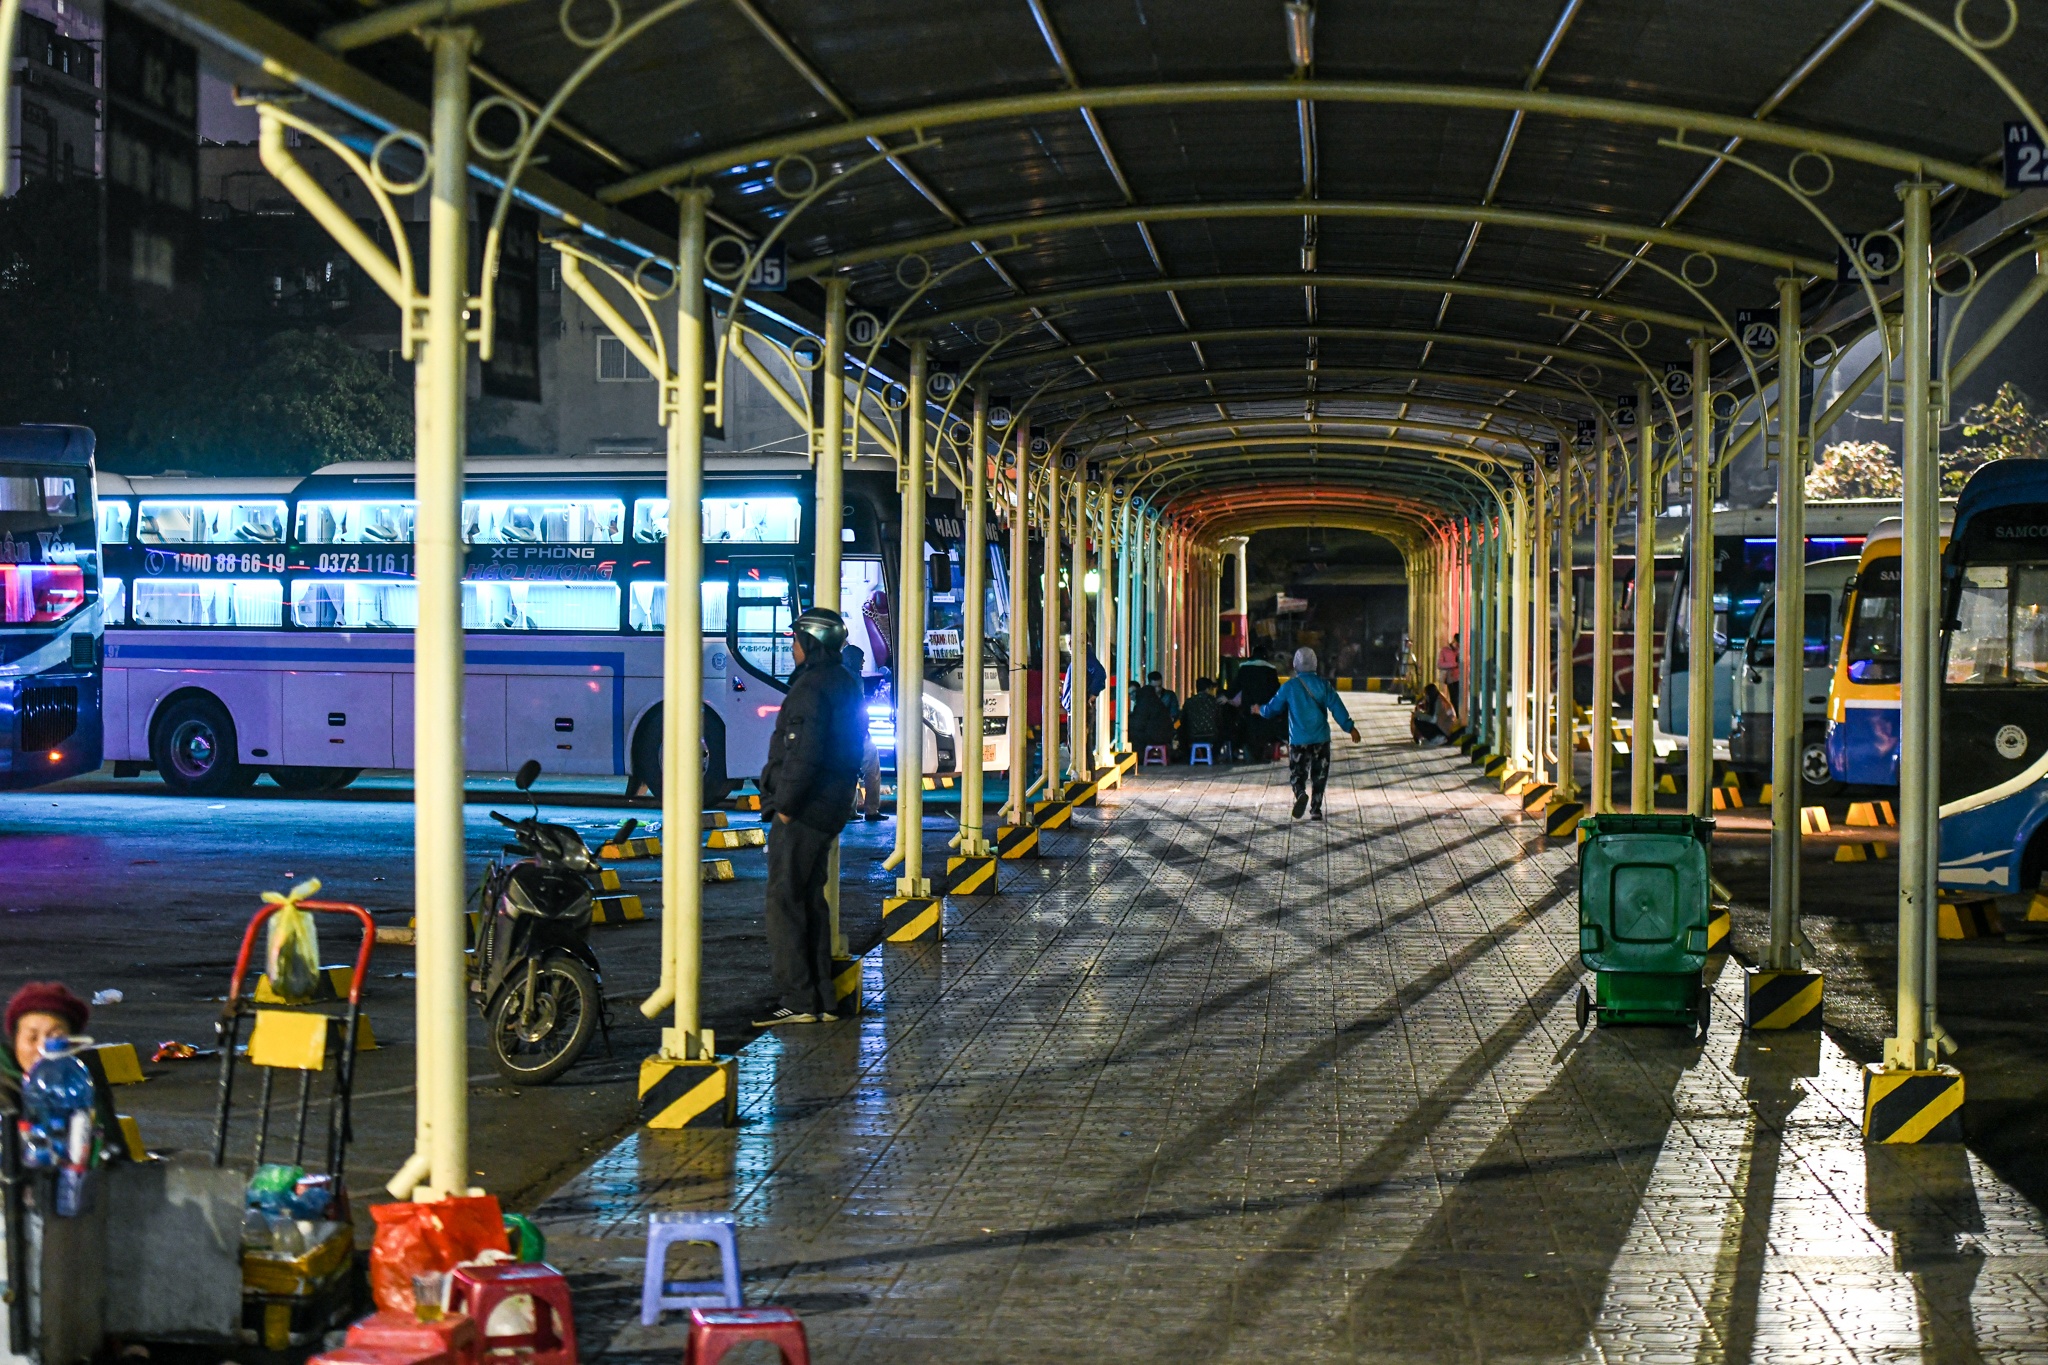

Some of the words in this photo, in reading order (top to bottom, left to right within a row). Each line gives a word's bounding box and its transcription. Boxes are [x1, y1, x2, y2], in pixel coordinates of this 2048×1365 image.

[2008, 126, 2028, 142] A1
[2018, 146, 2048, 181] 2
[1739, 311, 1751, 321] A1
[1744, 323, 1774, 346] 24
[1667, 364, 1677, 373] A1
[934, 514, 960, 537] HÀO
[0, 531, 32, 562] ân
[37, 524, 77, 562] Yến
[491, 548, 518, 559] XE
[525, 545, 595, 559] PHÒNG
[173, 553, 211, 573] 1900
[216, 553, 236, 573] 88
[240, 553, 260, 573] 66
[266, 553, 286, 573] 19
[319, 553, 359, 573] 0373
[366, 553, 395, 573] 116
